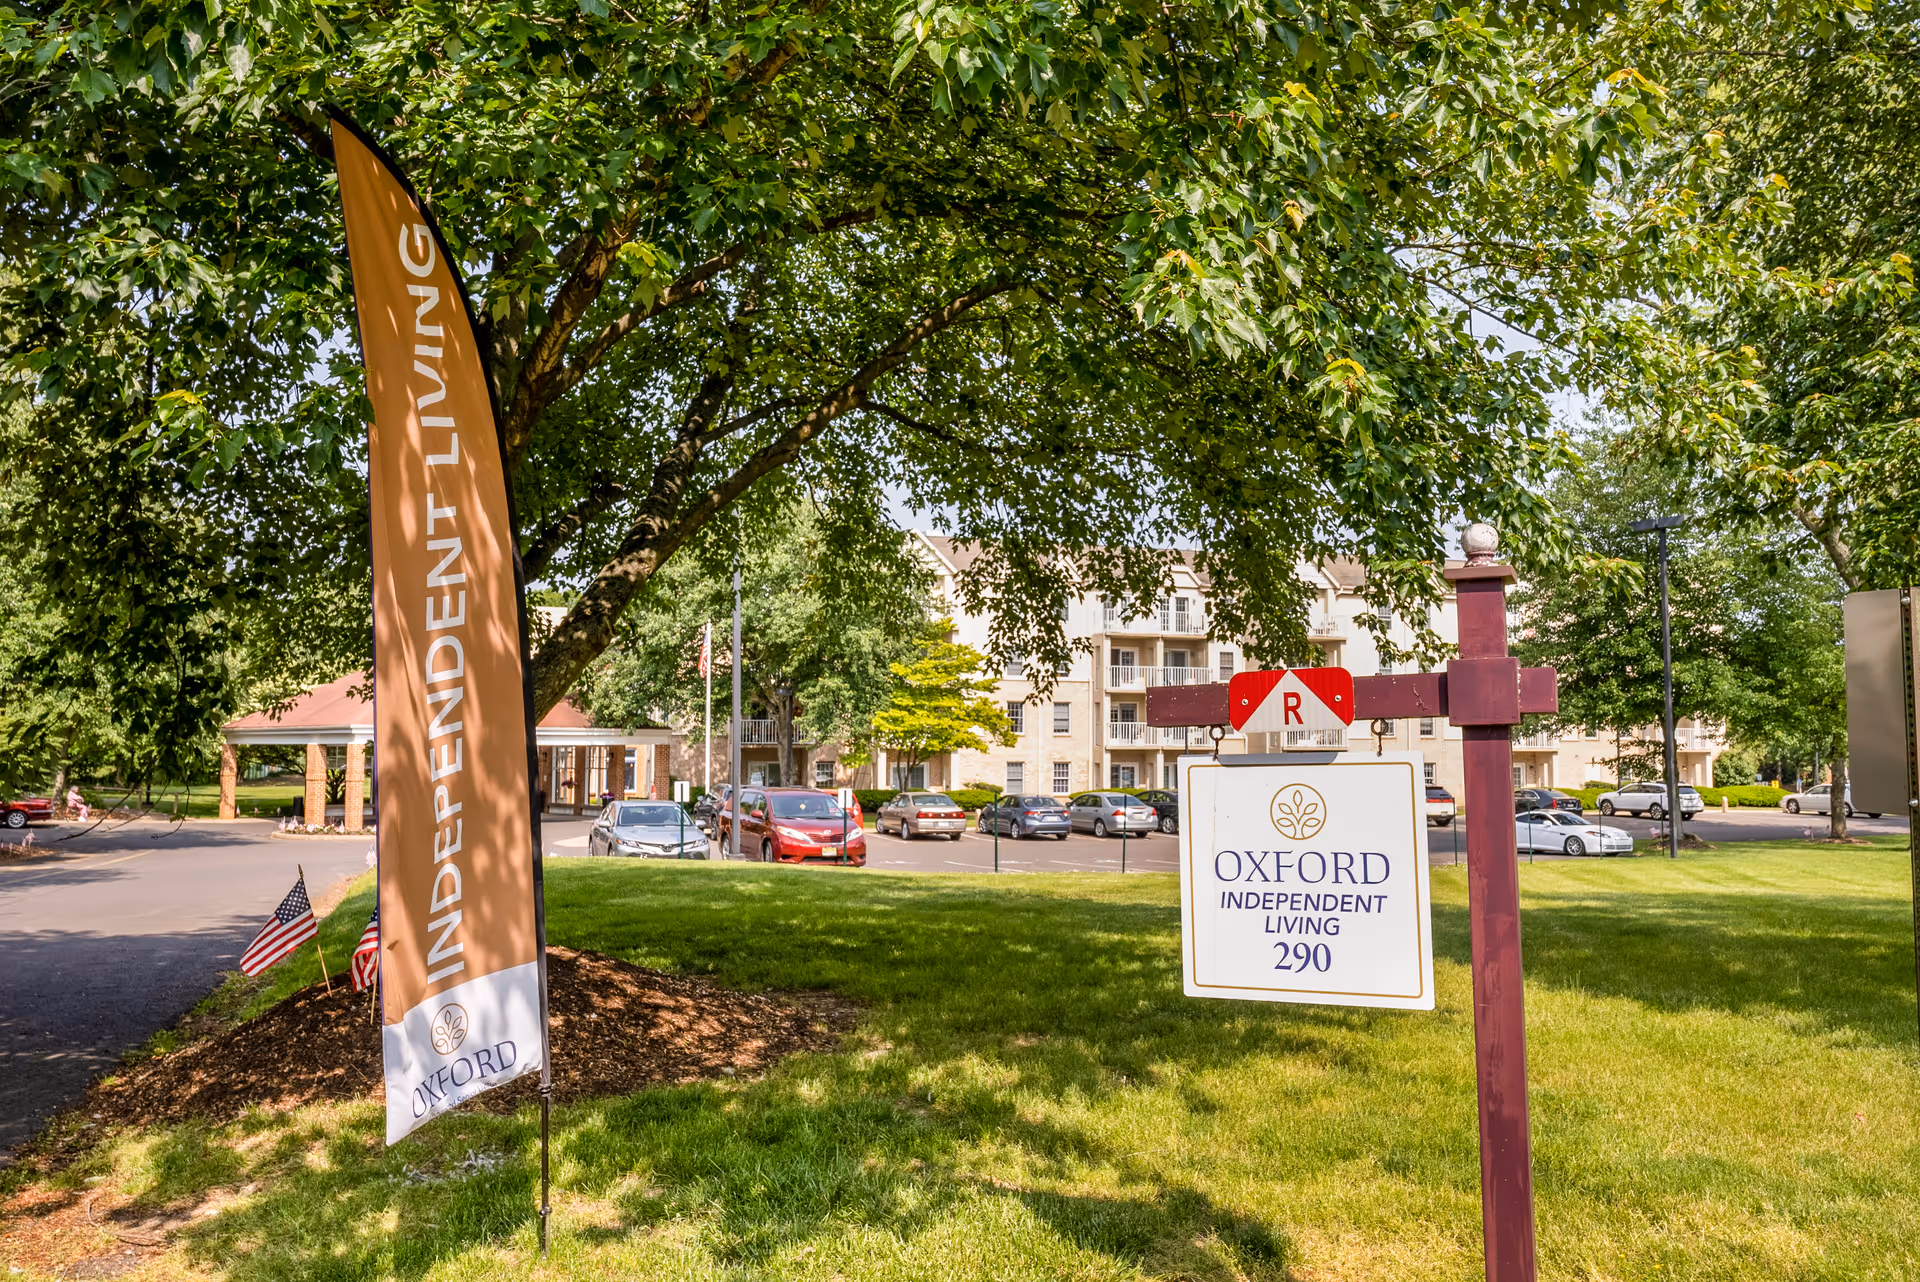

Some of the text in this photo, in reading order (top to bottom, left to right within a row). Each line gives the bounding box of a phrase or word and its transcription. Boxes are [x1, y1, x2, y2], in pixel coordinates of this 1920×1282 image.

[399, 222, 467, 985] INDEPENDENT LIVING
[1283, 691, 1304, 726] R
[1214, 849, 1391, 886] OXFORD
[1220, 891, 1388, 914] INDEPENDENT
[1264, 915, 1341, 936] LIVING
[1272, 941, 1332, 973] 290
[412, 1040, 517, 1118] OXFORD
